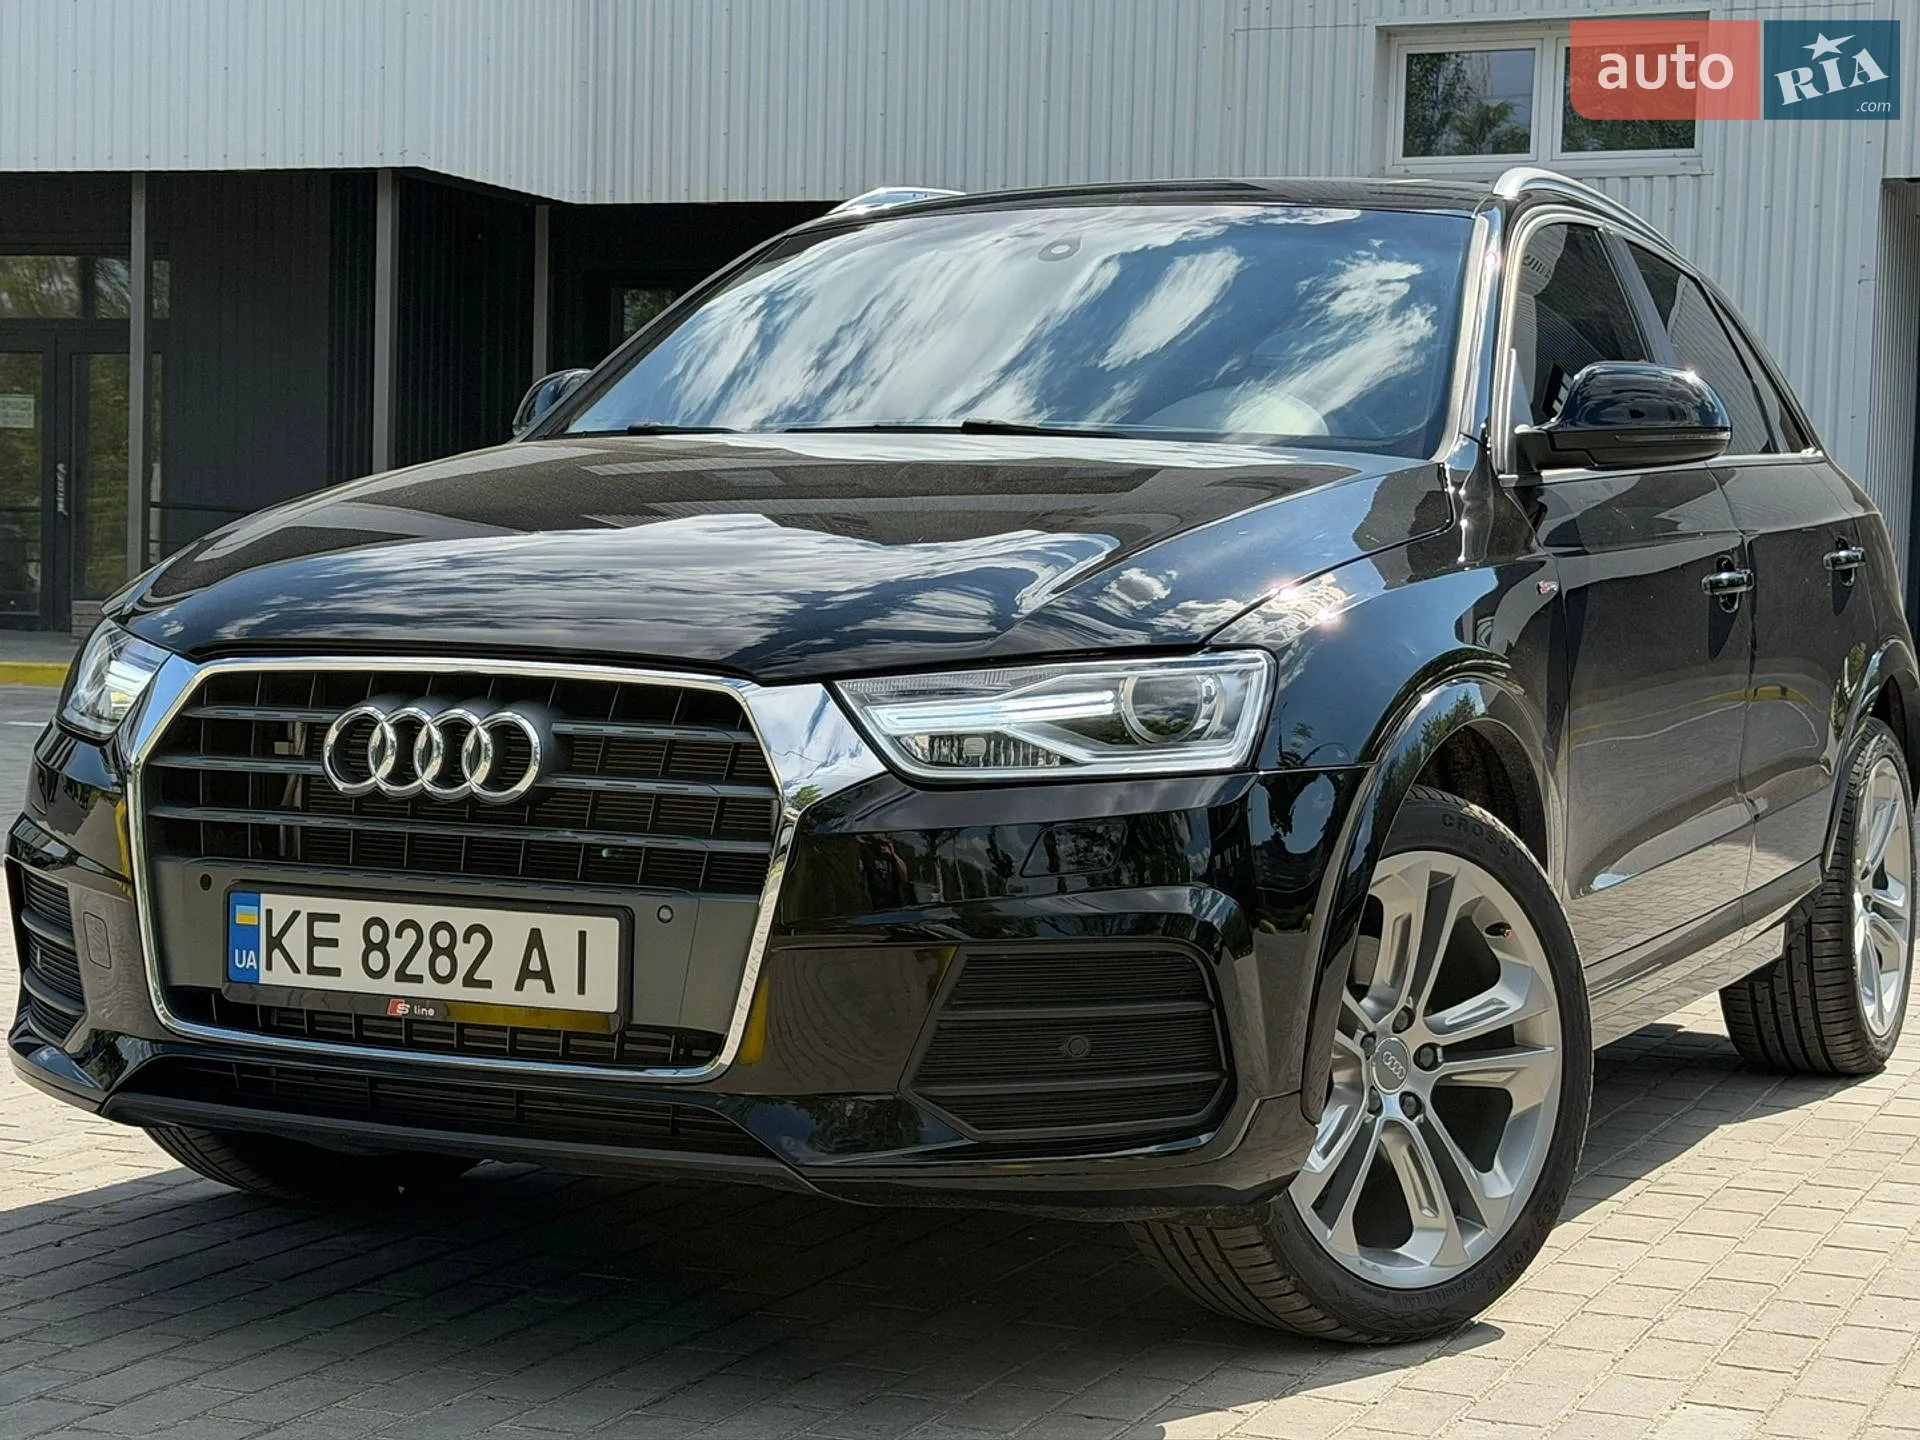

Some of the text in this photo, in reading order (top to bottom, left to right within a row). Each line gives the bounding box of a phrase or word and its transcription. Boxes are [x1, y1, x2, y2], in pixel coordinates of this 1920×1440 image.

[234, 949, 258, 970] UA
[265, 908, 587, 995] KE 8282 AI
[413, 1004, 435, 1016] line
